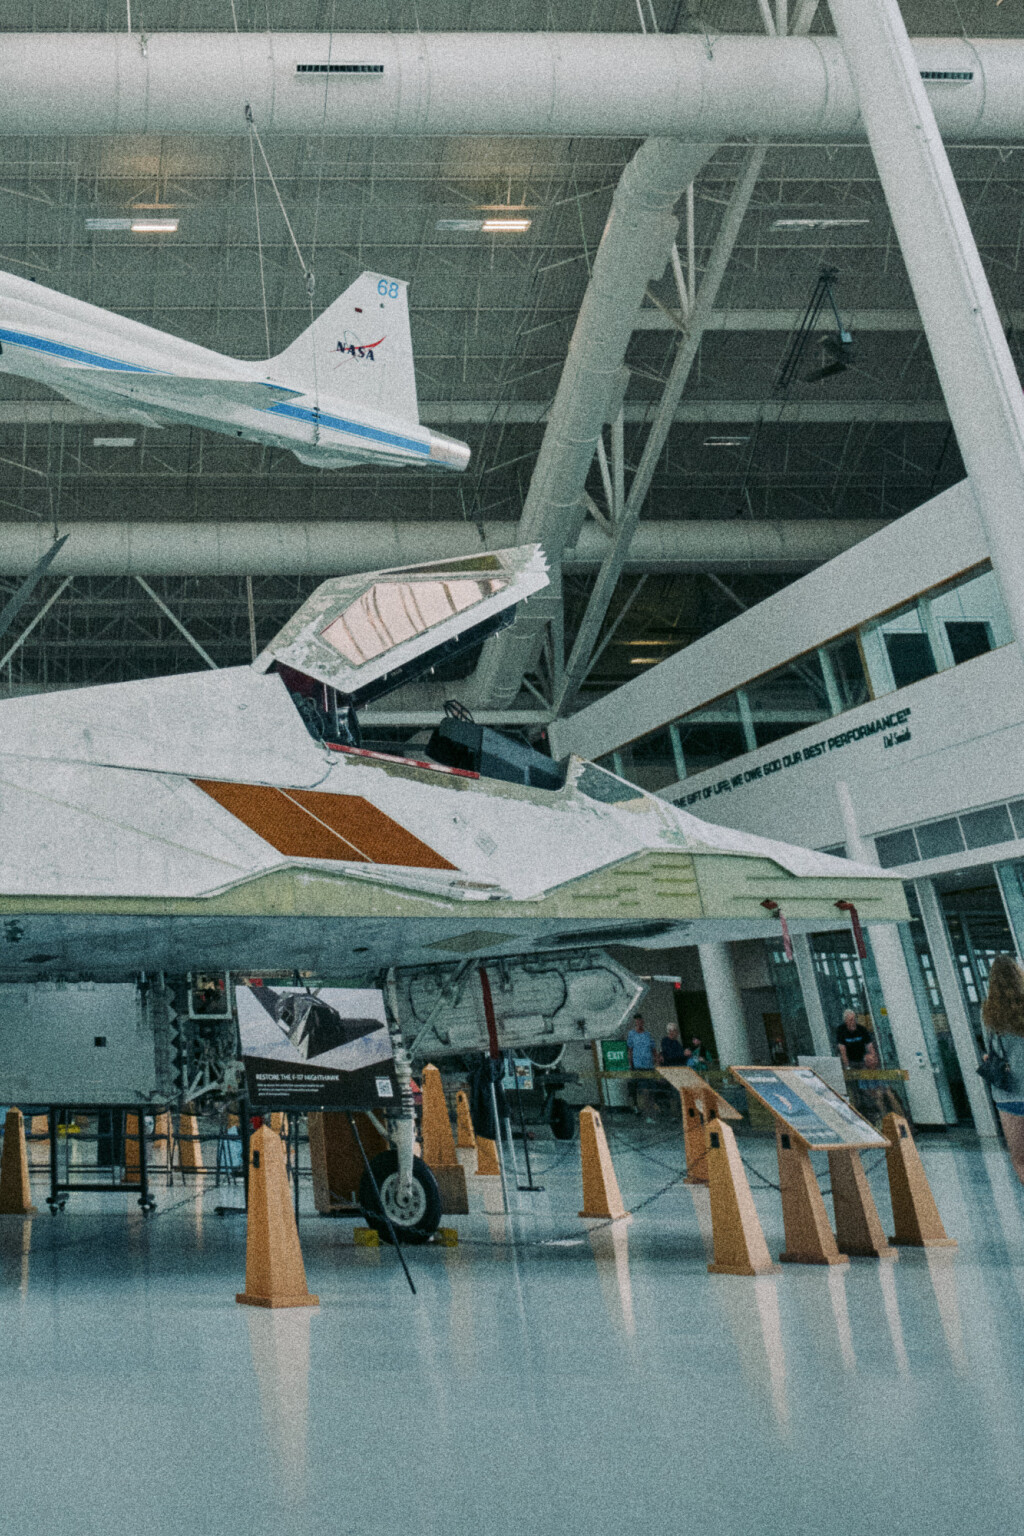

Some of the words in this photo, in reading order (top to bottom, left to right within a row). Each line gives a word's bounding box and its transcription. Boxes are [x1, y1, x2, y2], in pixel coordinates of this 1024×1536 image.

[377, 279, 399, 299] 68
[336, 341, 375, 361] NASA
[687, 790, 702, 805] GIFT
[703, 786, 713, 799] OF
[731, 774, 744, 788] WE
[744, 766, 763, 782] OWE
[763, 759, 782, 775] GOD
[782, 750, 802, 768] OUR
[803, 740, 826, 760] BEST
[607, 1051, 624, 1060] EXIT
